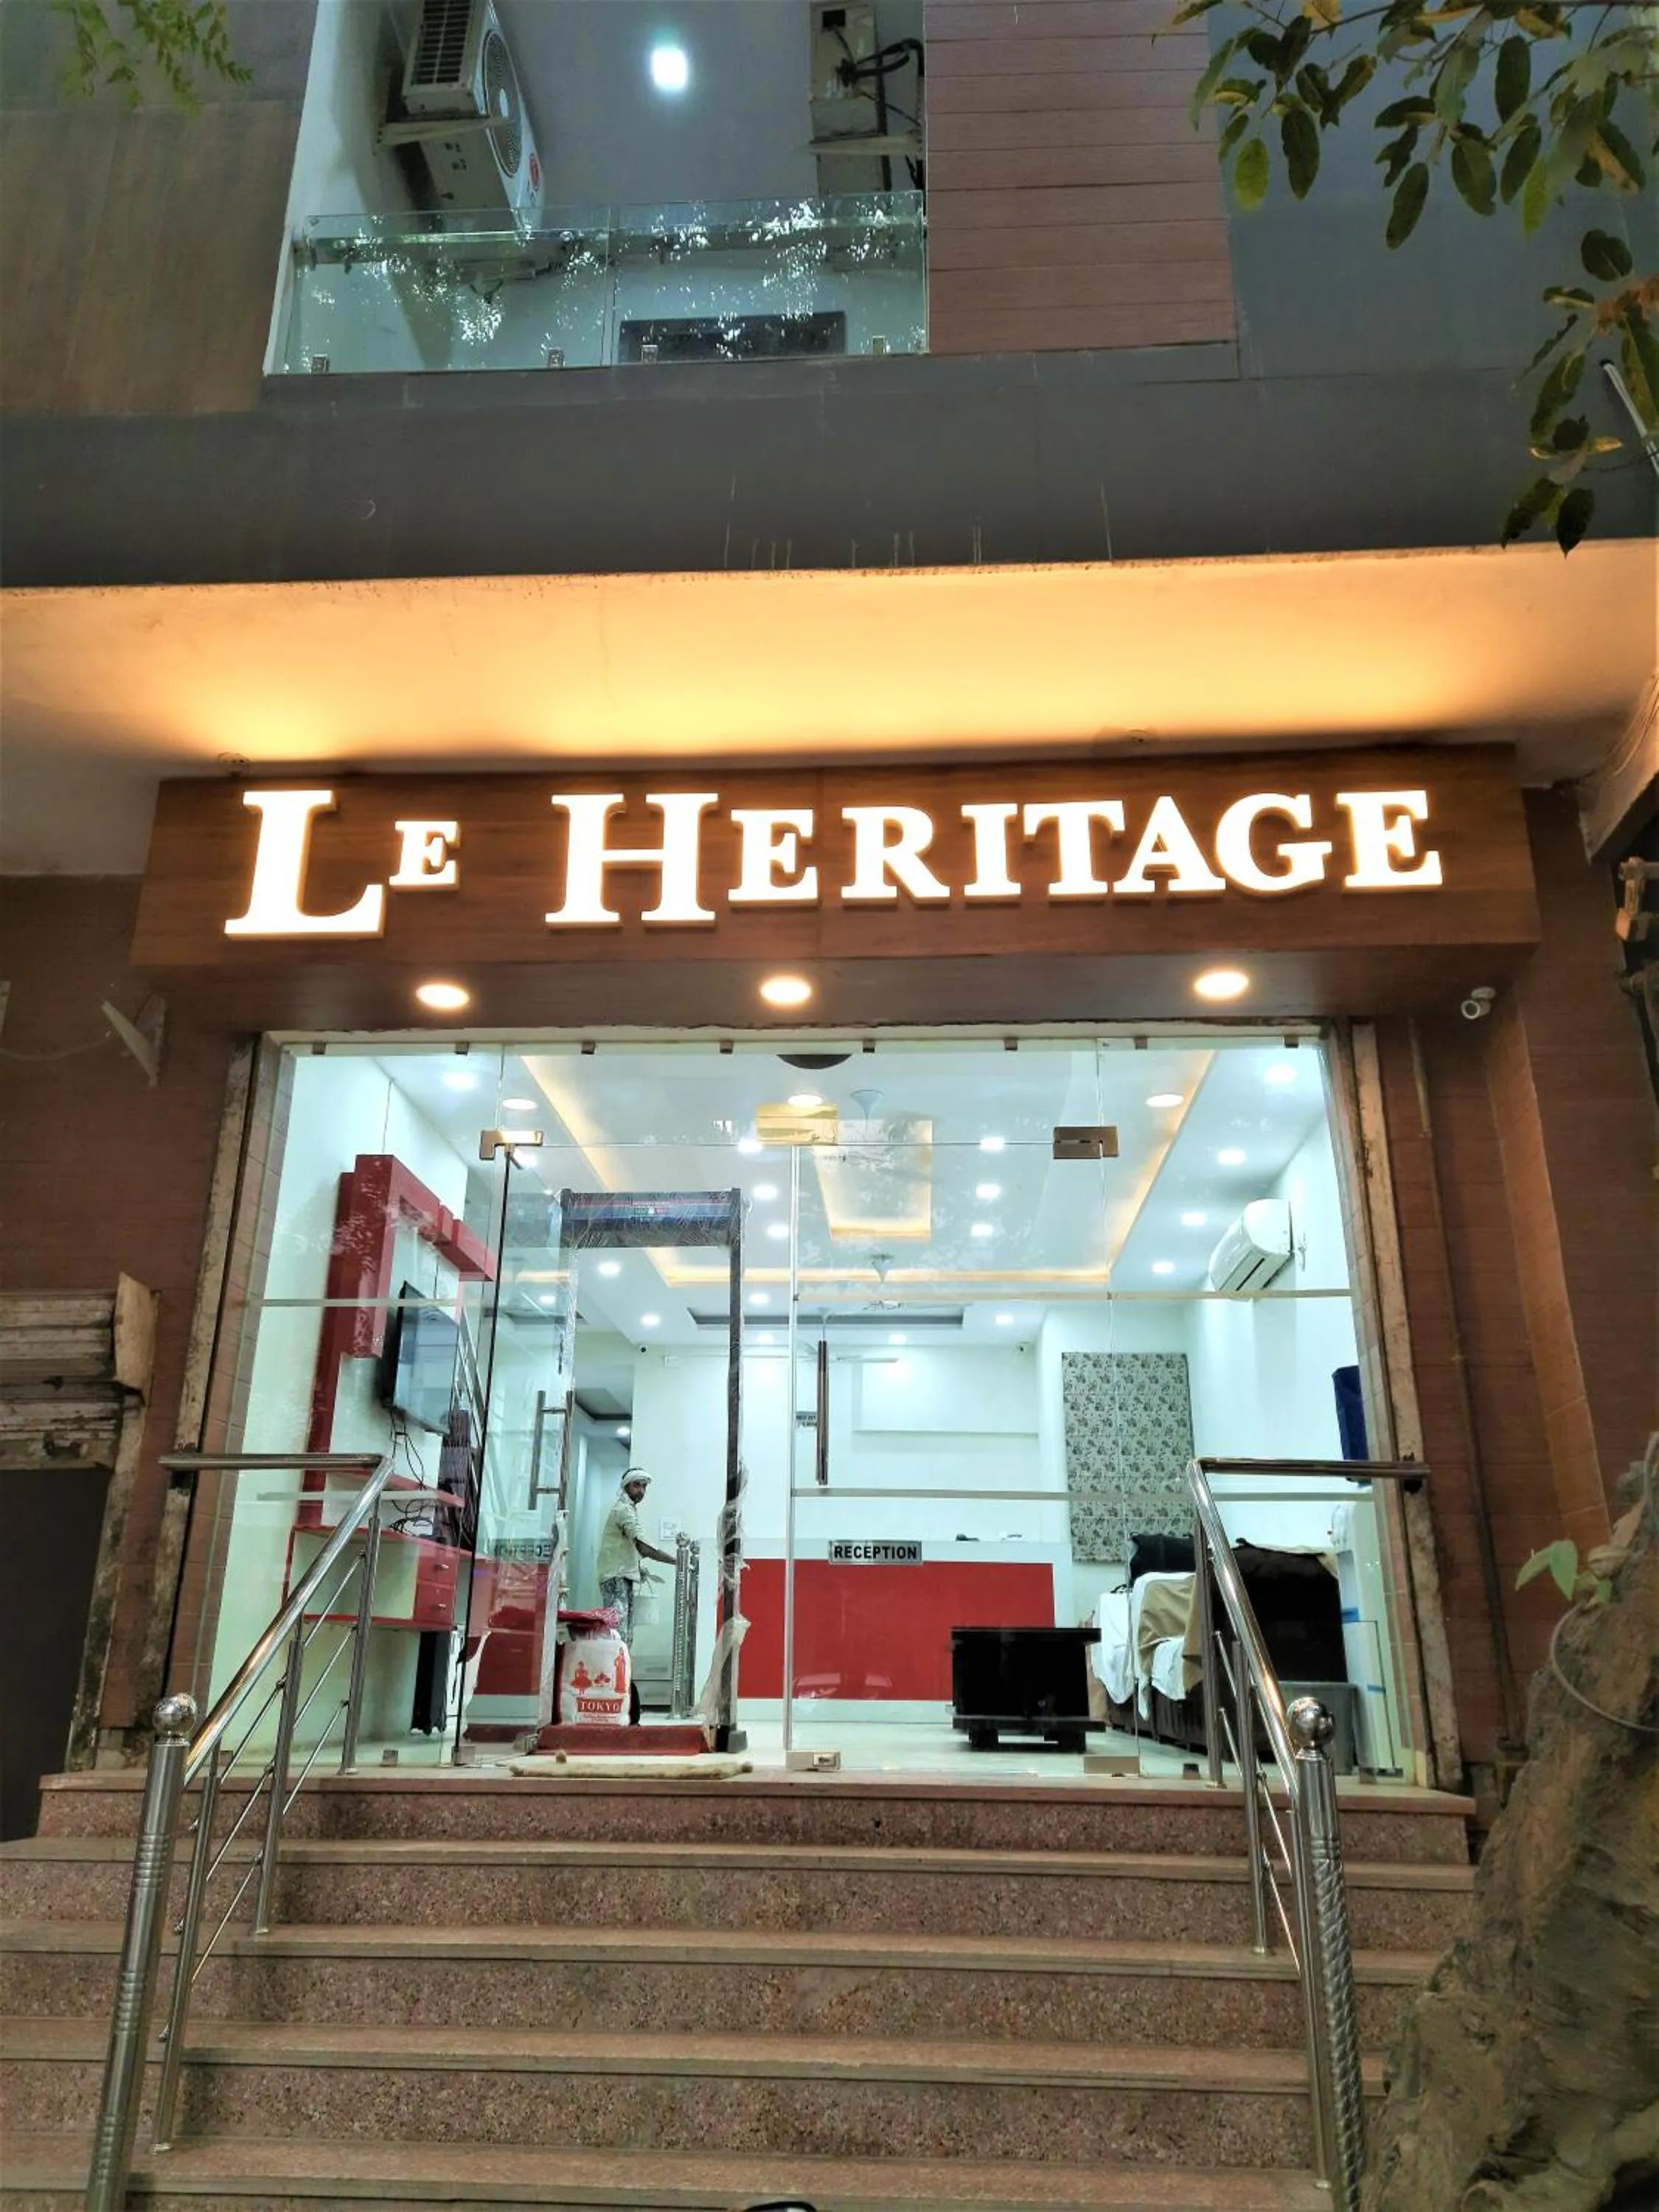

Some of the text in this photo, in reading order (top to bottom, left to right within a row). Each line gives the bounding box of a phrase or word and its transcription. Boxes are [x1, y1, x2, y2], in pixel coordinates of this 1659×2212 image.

[545, 790, 1444, 926] HERITAGE
[834, 1545, 917, 1559] RECEPTION
[580, 1700, 621, 1711] TOKYO
